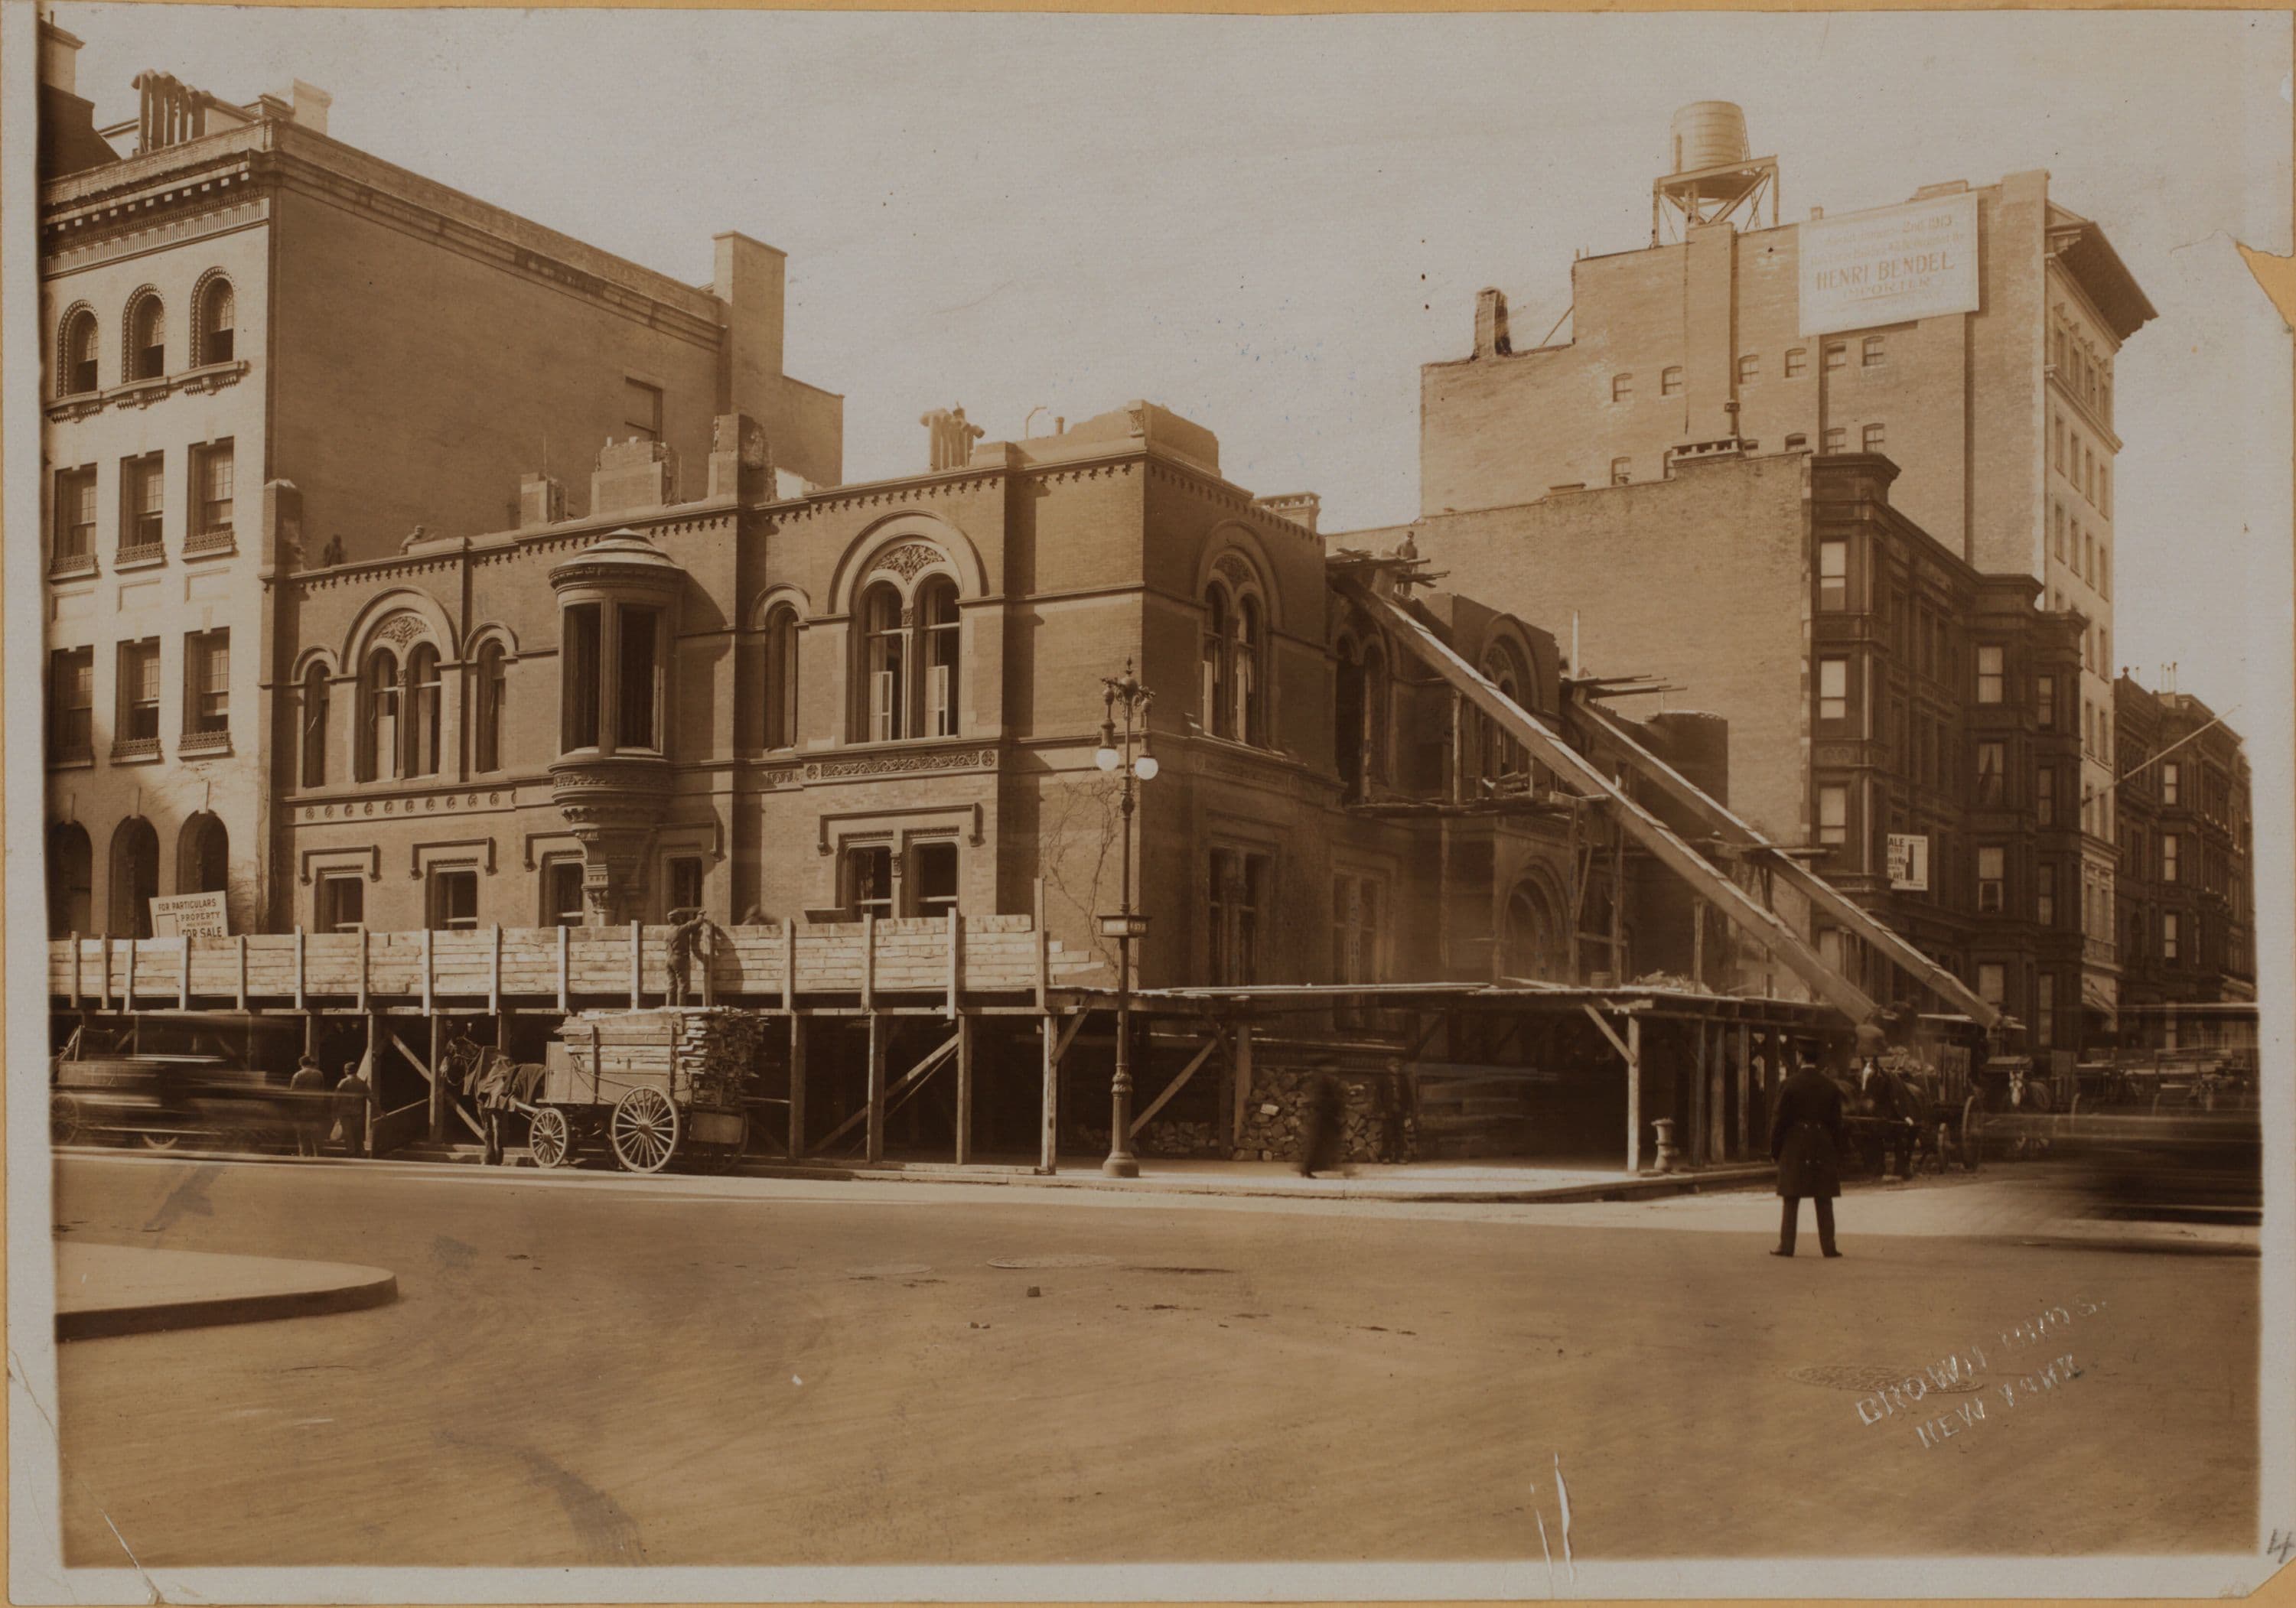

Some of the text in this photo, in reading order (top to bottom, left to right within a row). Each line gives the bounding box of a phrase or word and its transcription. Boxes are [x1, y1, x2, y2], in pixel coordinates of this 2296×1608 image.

[1816, 251, 1955, 291] HENRI BENDEL
[172, 898, 217, 910] PARTICULARS
[181, 911, 220, 922] PROPERTY
[182, 926, 222, 938] FOR SALE
[2267, 1528, 2295, 1564] 4
